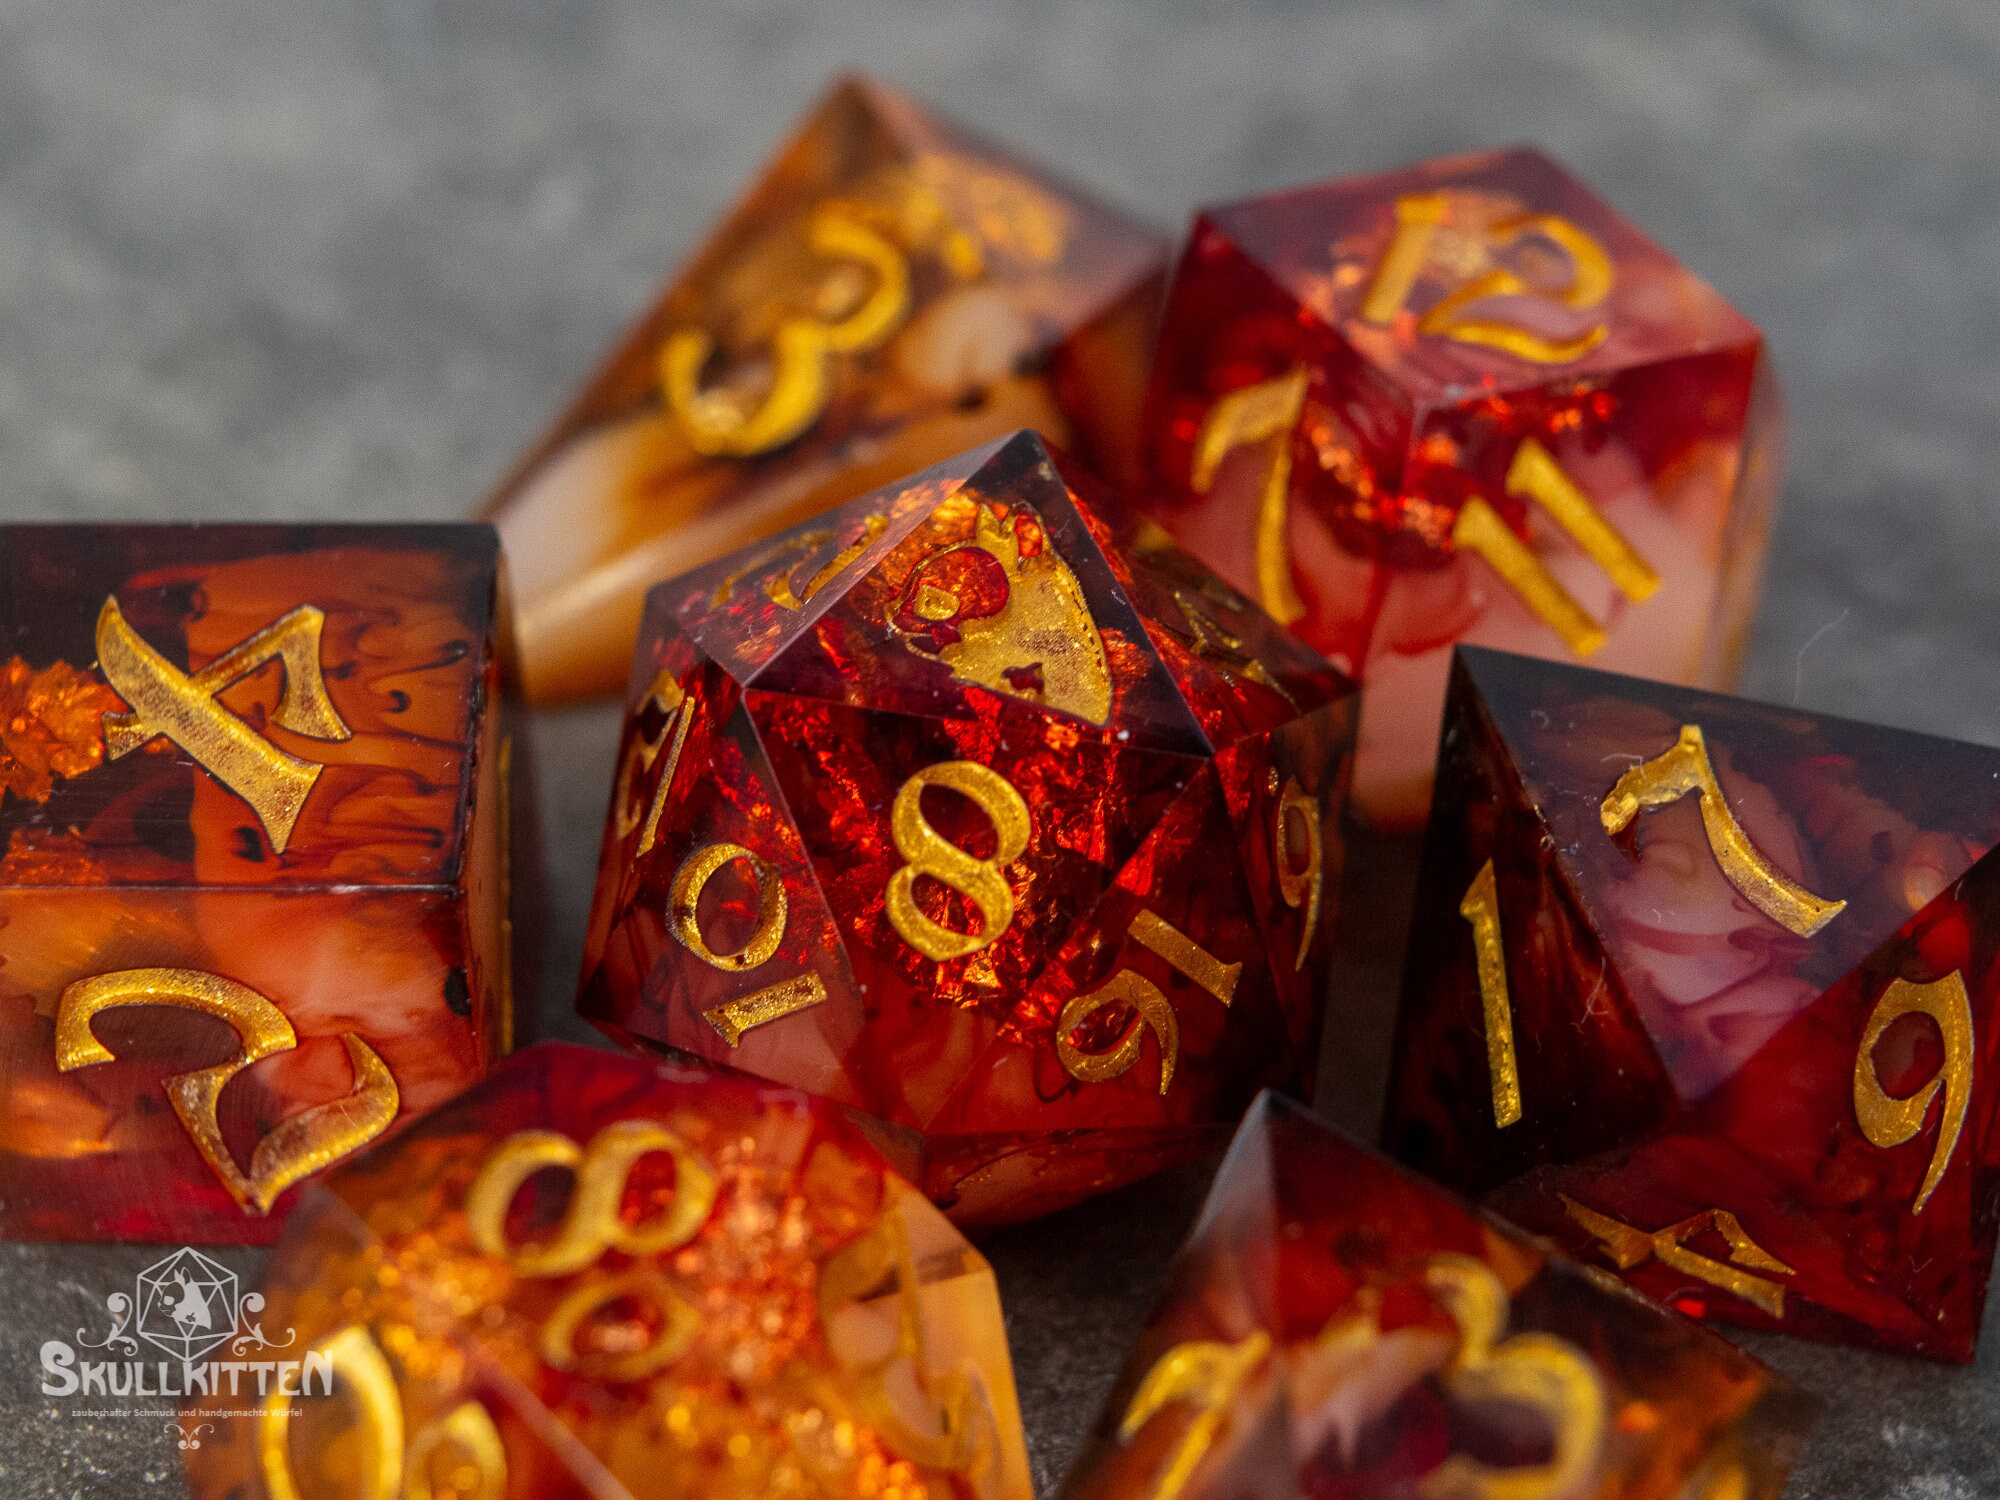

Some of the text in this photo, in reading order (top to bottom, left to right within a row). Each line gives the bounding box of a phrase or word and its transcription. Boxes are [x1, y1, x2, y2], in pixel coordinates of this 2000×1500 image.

[663, 205, 911, 456] 3
[1361, 195, 1613, 362] 12
[1452, 436, 1662, 657] 11
[886, 760, 1031, 961] 8
[1601, 724, 1847, 938] 7
[1460, 858, 1522, 1128] 1
